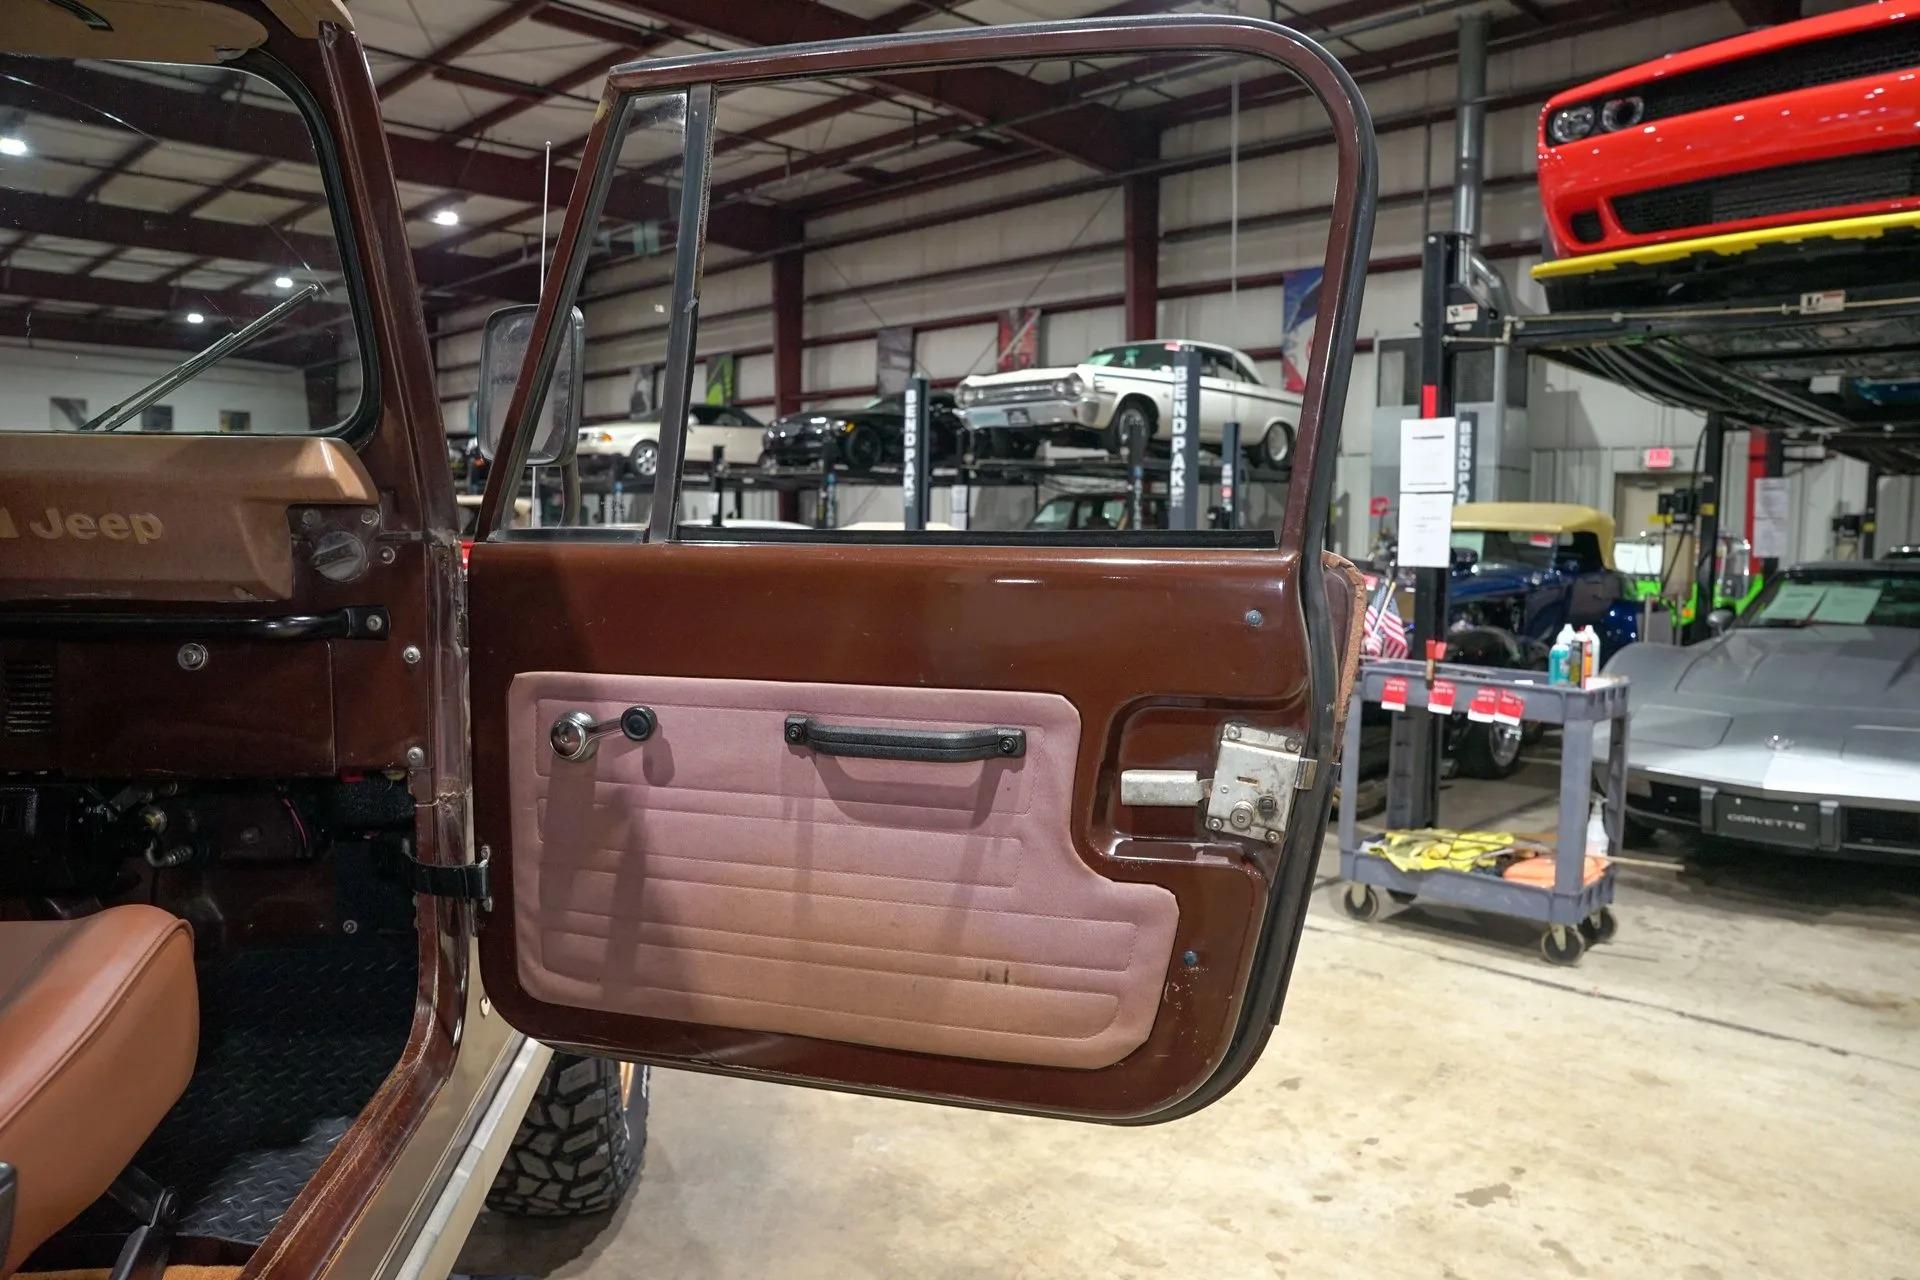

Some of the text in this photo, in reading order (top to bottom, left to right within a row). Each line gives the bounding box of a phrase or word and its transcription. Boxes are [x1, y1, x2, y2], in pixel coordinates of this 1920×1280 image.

[904, 389, 917, 491] BENDPAK
[1170, 366, 1188, 486] BENDPAK
[29, 507, 164, 545] Jeep
[1726, 813, 1807, 831] CORVETTE
